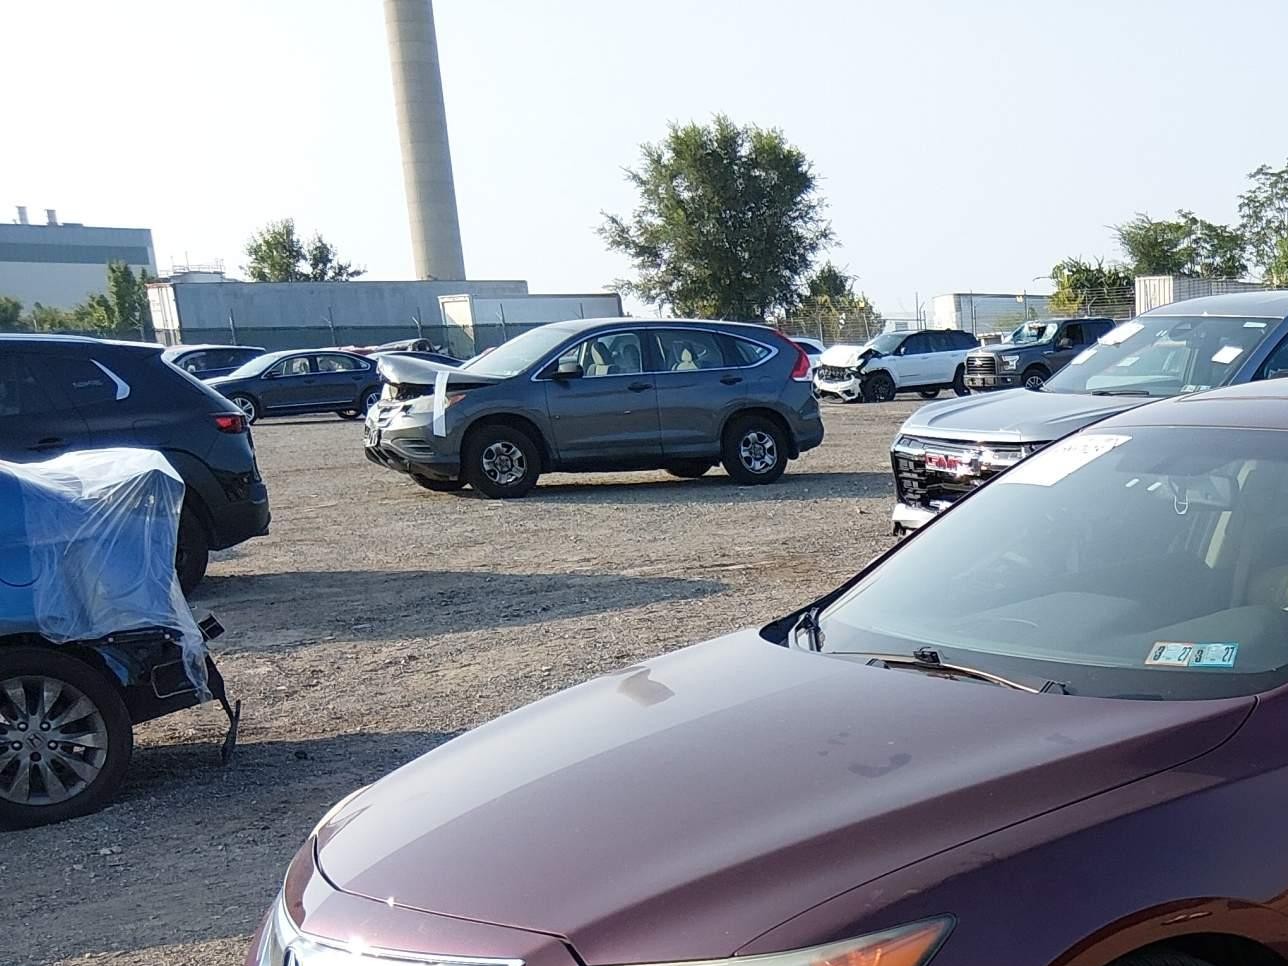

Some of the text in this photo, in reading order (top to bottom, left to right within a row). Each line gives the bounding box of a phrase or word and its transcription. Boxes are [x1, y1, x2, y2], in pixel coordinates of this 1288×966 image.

[1153, 646, 1192, 662] 3 27
[1195, 646, 1235, 663] 3 27
